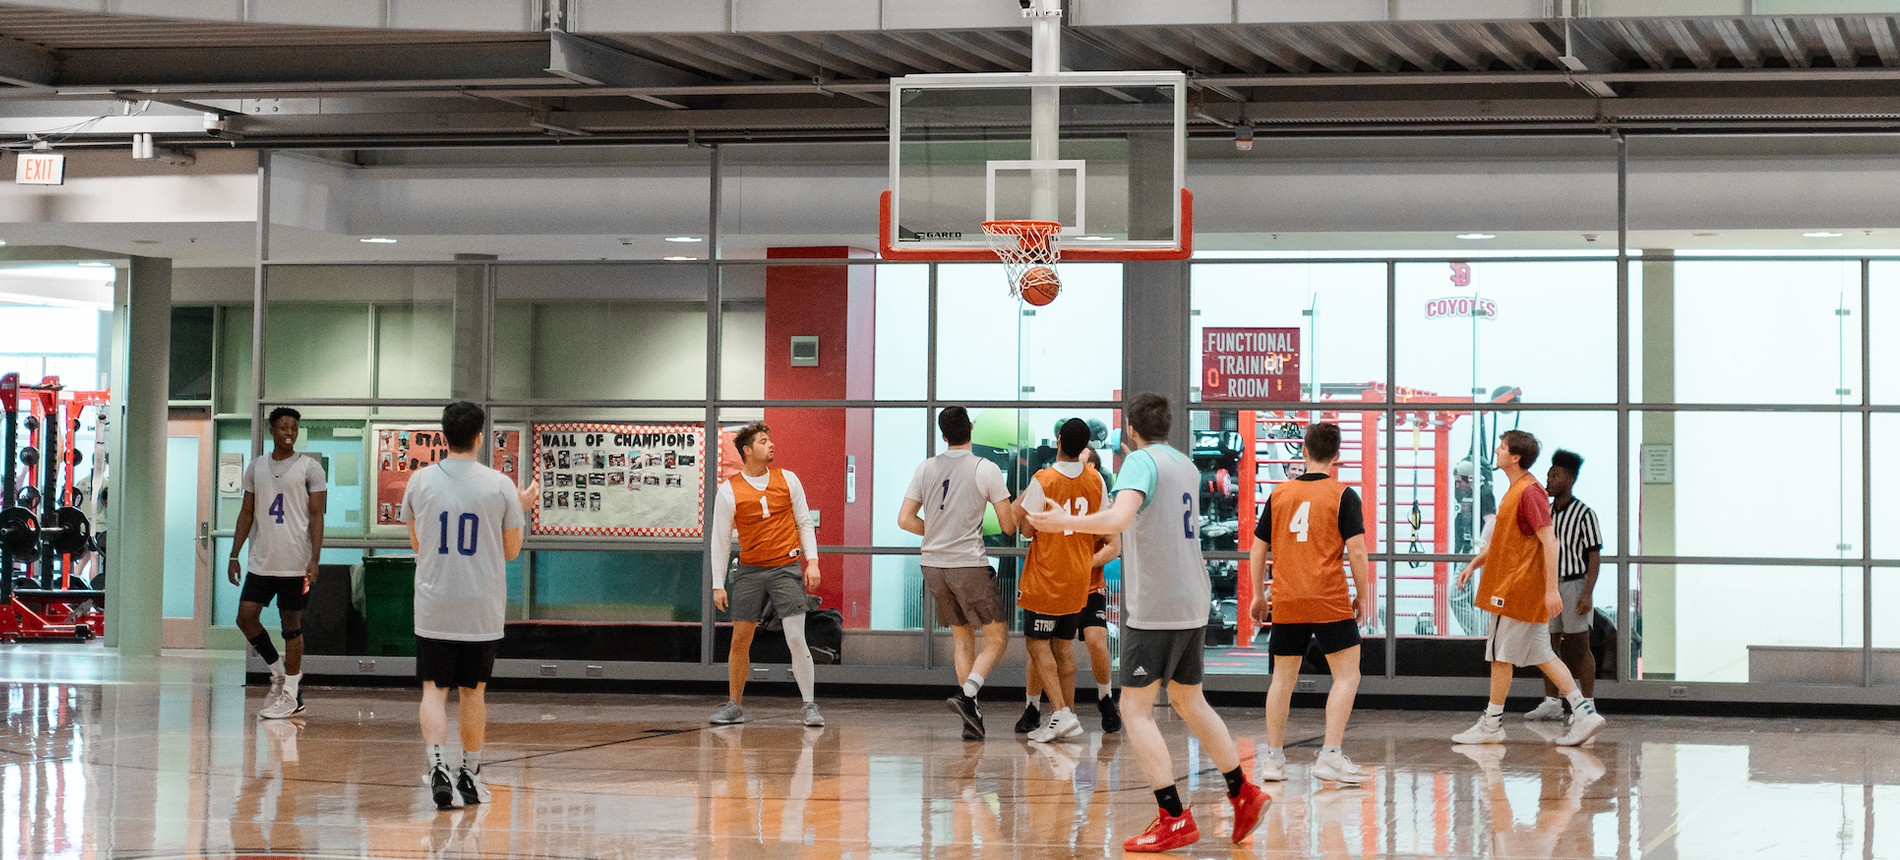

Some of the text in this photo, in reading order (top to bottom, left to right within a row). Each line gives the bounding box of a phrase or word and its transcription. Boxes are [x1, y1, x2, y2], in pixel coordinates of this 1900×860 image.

[25, 159, 54, 180] EXIT
[1208, 332, 1295, 352] FUNCTIONAL
[1218, 355, 1284, 375] TRAINING
[1228, 378, 1269, 397] ROOM
[542, 434, 695, 449] WALL OF CHAMPIONS
[269, 493, 285, 524] 4
[759, 495, 771, 518] 1
[1182, 492, 1195, 539] 2
[1290, 501, 1311, 542] 4
[438, 511, 479, 556] 10
